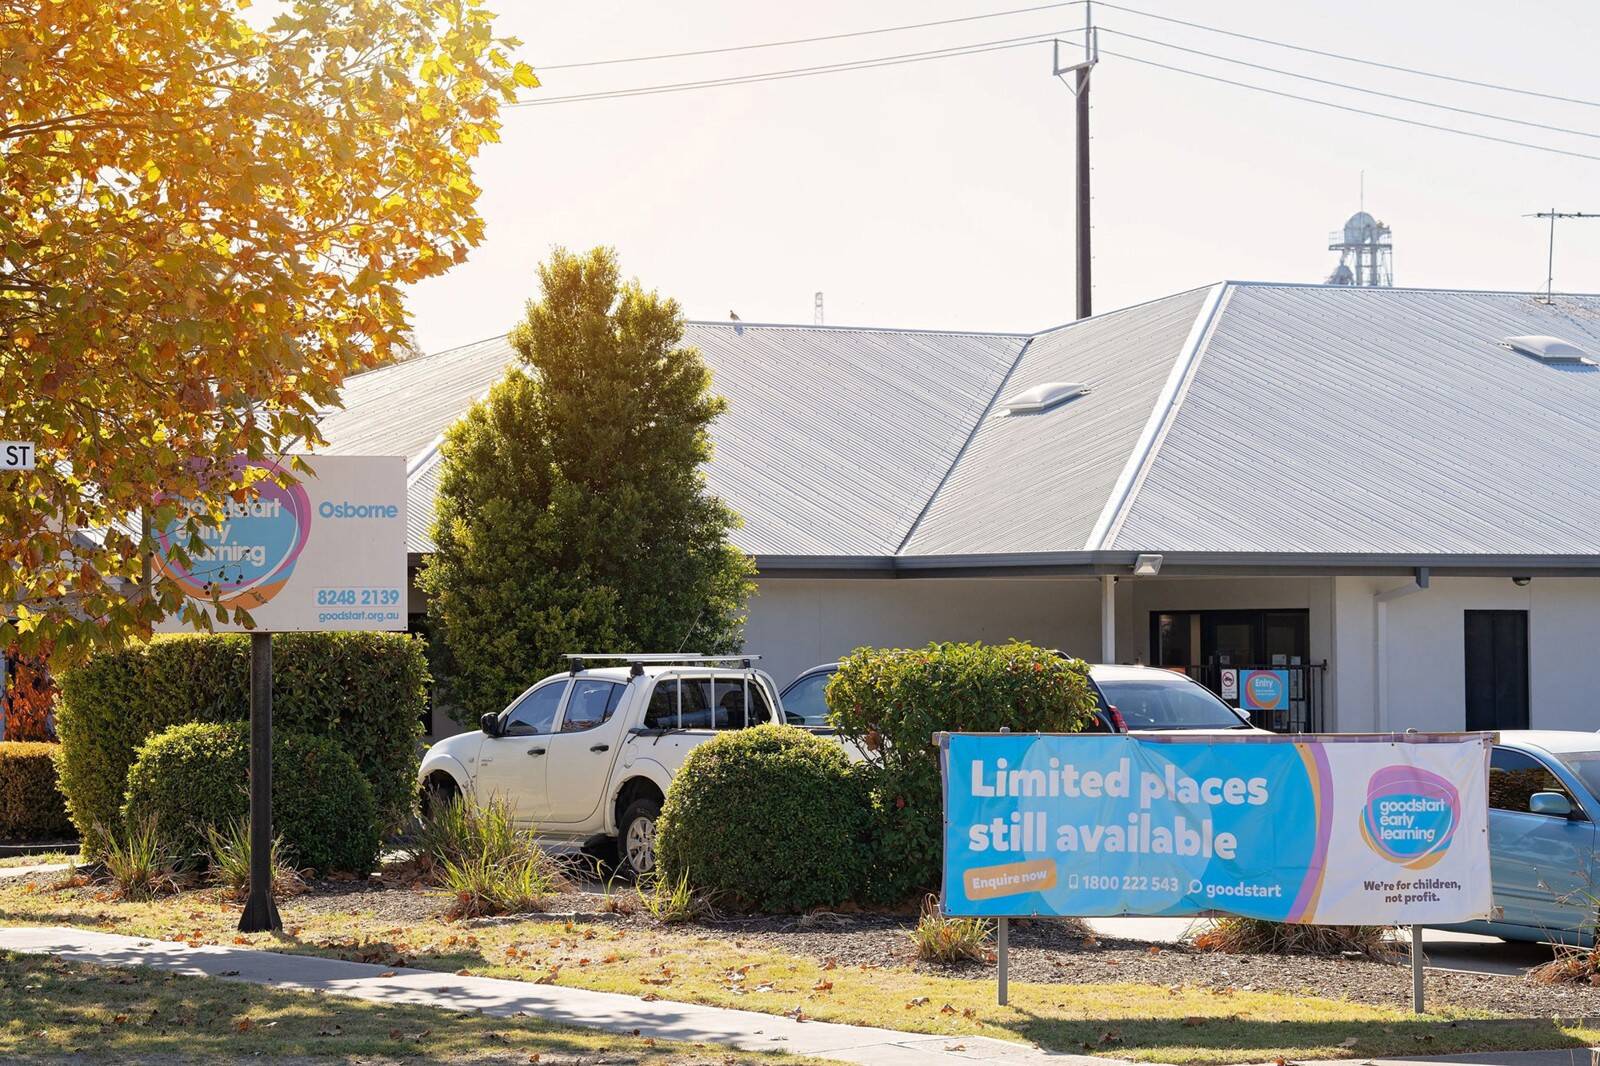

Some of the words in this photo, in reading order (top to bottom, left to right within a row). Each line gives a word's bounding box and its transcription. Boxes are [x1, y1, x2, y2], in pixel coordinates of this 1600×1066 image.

[6, 445, 30, 466] ST
[318, 501, 398, 518] Osborne
[317, 589, 356, 605] 8248
[361, 589, 400, 605] 2139
[318, 610, 399, 623] goodstart.org.au
[1255, 678, 1274, 689] Entry
[971, 758, 1130, 798] Limited
[1140, 764, 1269, 808] places
[1380, 798, 1445, 816] goodstart
[1380, 812, 1415, 829] early
[968, 811, 1047, 851] still
[1056, 812, 1238, 860] available
[1380, 827, 1436, 842] learning
[972, 873, 1020, 890] Enquire
[1022, 870, 1048, 882] now
[1082, 875, 1119, 890] 1800
[1122, 876, 1148, 891] 222
[1151, 877, 1179, 892] 543
[1396, 880, 1411, 890] for
[1412, 878, 1461, 891] children,
[1206, 881, 1282, 898] goodstart
[1385, 893, 1402, 903] not
[1404, 892, 1440, 905] profit.
